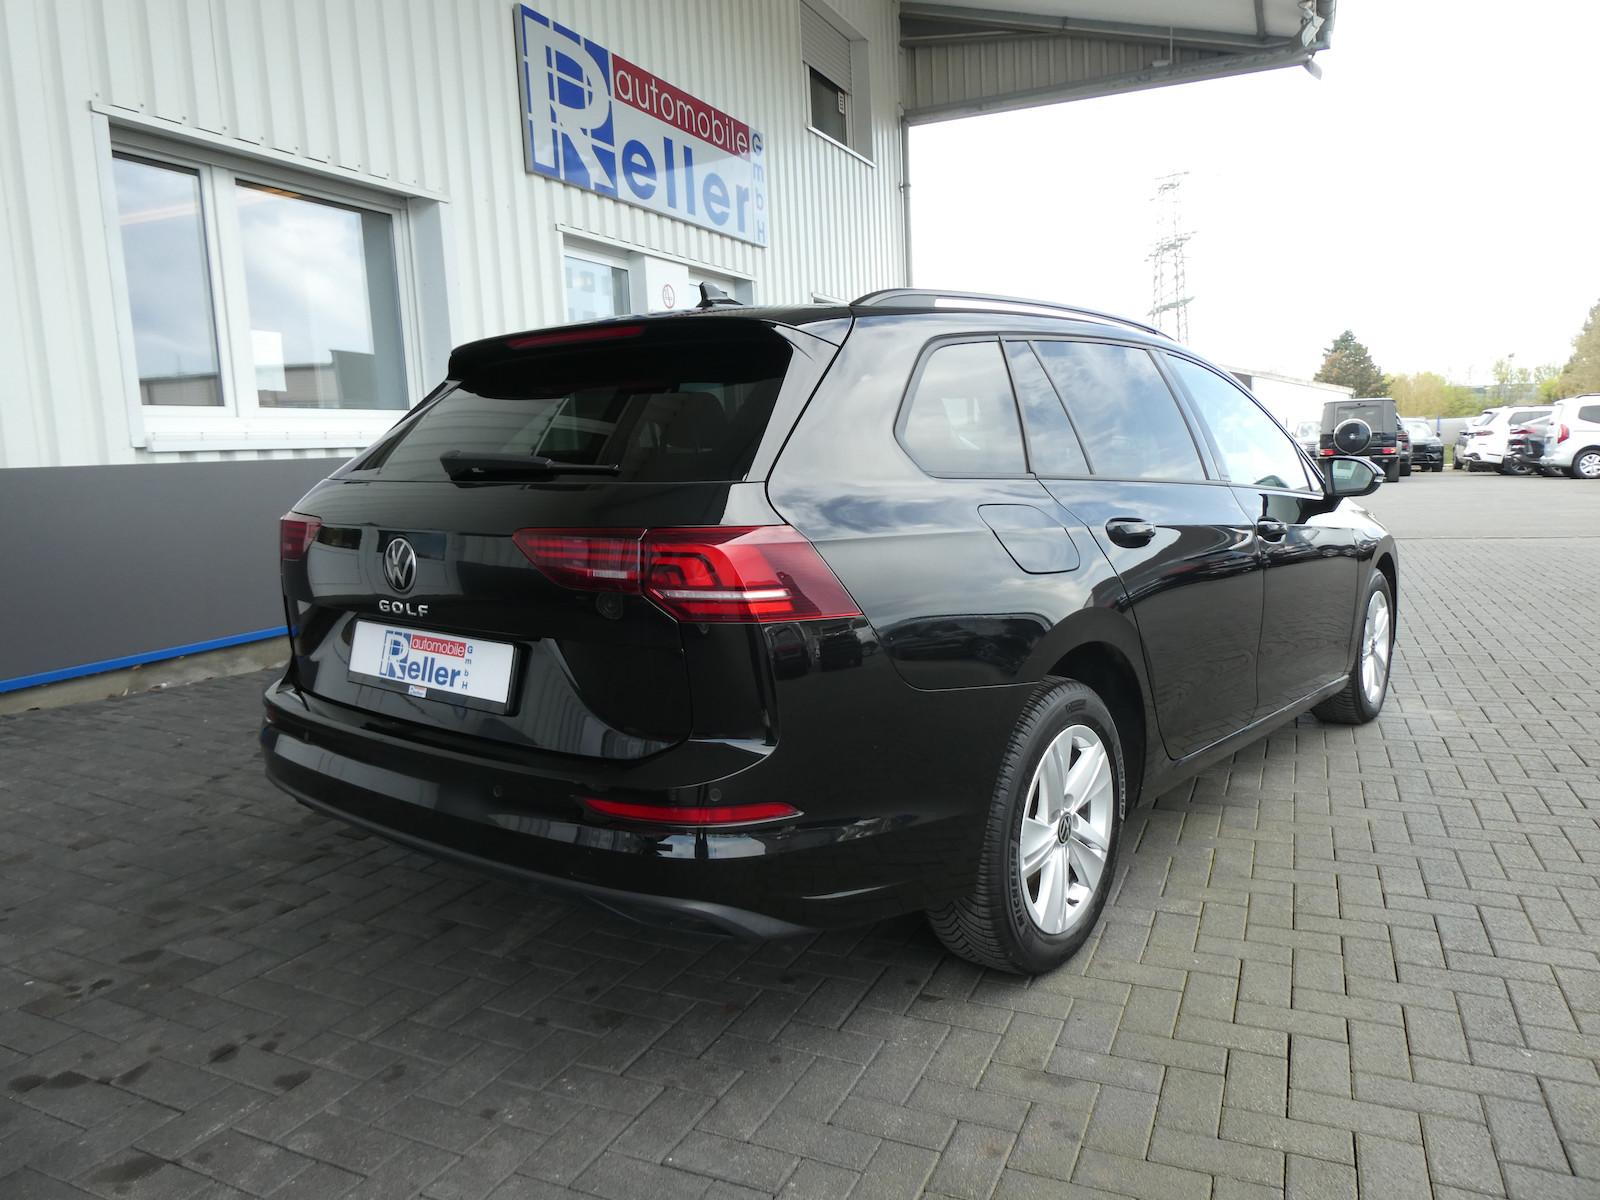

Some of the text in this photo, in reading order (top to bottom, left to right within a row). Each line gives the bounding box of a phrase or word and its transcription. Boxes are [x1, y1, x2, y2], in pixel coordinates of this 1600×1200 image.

[615, 69, 749, 155] automobile
[752, 132, 767, 245] GmbH
[378, 599, 429, 616] GOLF
[412, 638, 465, 657] automobile
[461, 645, 474, 690] GmbH
[1010, 846, 1025, 927] MICHELIN
